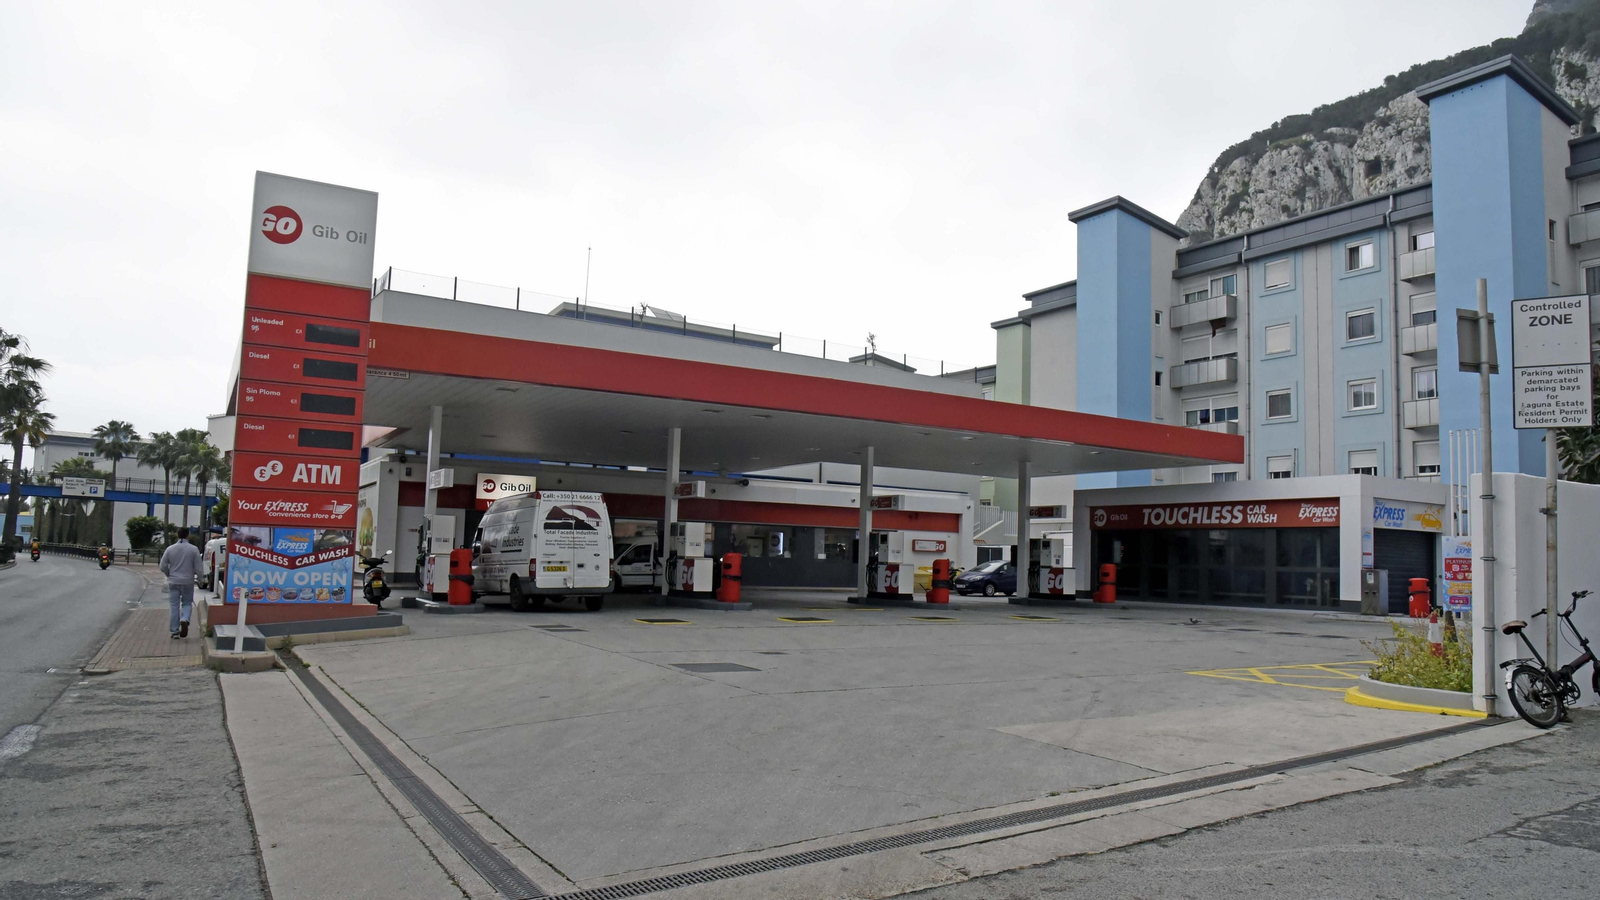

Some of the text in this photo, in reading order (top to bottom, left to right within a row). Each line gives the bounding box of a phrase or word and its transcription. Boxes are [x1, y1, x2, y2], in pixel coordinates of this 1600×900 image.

[261, 212, 297, 235] GO
[312, 224, 368, 245] Gib Oil
[1520, 300, 1581, 313] Controlled
[251, 316, 284, 326] Unleaded
[1528, 313, 1573, 327] ZONE
[368, 338, 376, 349] il
[248, 352, 270, 360] Diesel
[1521, 367, 1584, 378] Parking within
[1527, 377, 1579, 385] demarcated
[259, 388, 281, 396] Plomo
[1525, 384, 1581, 393] parking bays
[1555, 400, 1585, 408] Estate
[1518, 408, 1588, 418] Resident Permit
[1524, 416, 1582, 425] Holders Only
[243, 423, 265, 431] Diesel
[292, 462, 342, 485] ATM
[500, 482, 531, 493] Gib Oil
[237, 499, 309, 513] Your EXPRESS
[1246, 504, 1267, 514] CAR
[268, 511, 311, 519] convenience
[1142, 505, 1243, 525] TOUCHLESS
[1299, 505, 1339, 519] EXPRESS
[1373, 504, 1406, 521] EXPRESS
[1247, 513, 1278, 524] WASH
[276, 540, 309, 551] EXPRESS
[935, 543, 945, 551] GO
[234, 543, 349, 566] TOUCHLESS CAR WASH
[232, 570, 347, 587] NOW OPEN
[884, 570, 899, 588] GO
[1047, 573, 1064, 590] GO
